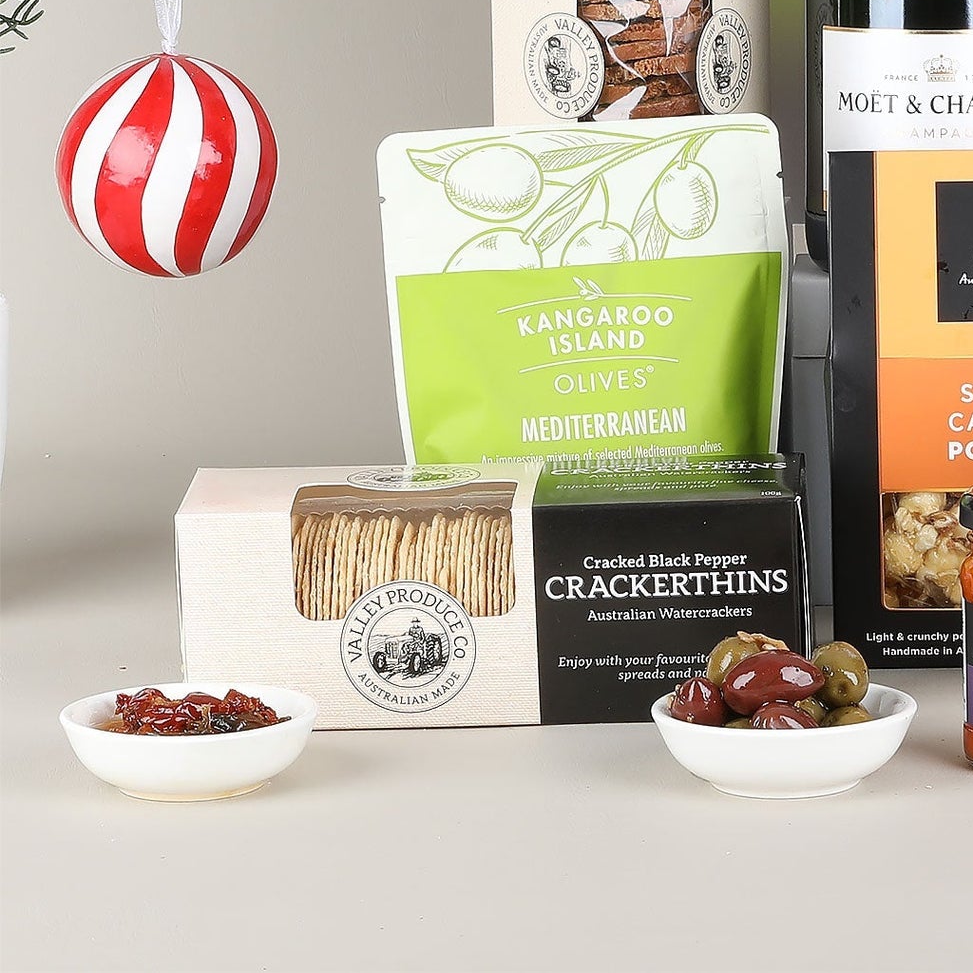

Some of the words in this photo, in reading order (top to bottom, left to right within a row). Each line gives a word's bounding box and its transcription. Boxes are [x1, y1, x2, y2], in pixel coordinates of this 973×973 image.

[554, 18, 596, 52] VALLEY
[719, 16, 749, 41] VALLEY
[528, 23, 549, 79] AUSTRALIAN
[701, 24, 716, 79] AUSTRALIAN
[572, 53, 600, 112] PRODUCE
[728, 38, 751, 102] PRODUCE
[884, 74, 919, 82] FRANCE
[532, 78, 549, 104] MADE
[701, 79, 716, 105] MADE
[838, 89, 899, 114] MOËT
[906, 94, 923, 114] &
[516, 305, 674, 337] KANGAROO
[548, 329, 646, 356] ISLAND
[521, 407, 687, 443] MEDITERRANEAN
[481, 455, 495, 464] An
[495, 452, 544, 465] impressive
[547, 449, 580, 462] mixture
[583, 448, 592, 461] of
[595, 445, 632, 461] selected
[634, 442, 698, 459] Mediterranean
[699, 440, 725, 454] olives.
[550, 462, 788, 476] CRACKERTHINS
[583, 555, 646, 570] Cracked
[648, 553, 692, 568] Black
[694, 553, 748, 570] Pepper
[545, 569, 789, 601] CRACKERTHINS
[347, 595, 384, 663] VALLEY
[385, 588, 464, 633] PRODUCE
[453, 635, 469, 661] CO.
[587, 608, 657, 622] Australian
[658, 606, 753, 620] Watercrackers
[866, 632, 894, 643] Light
[896, 632, 905, 642] &
[907, 631, 949, 643] crunchy
[558, 656, 593, 669] Enjoy
[594, 654, 623, 667] with
[625, 657, 654, 669] your
[882, 647, 940, 656] Handmade
[943, 646, 953, 655] in
[358, 673, 429, 705] AUSTRALIAN
[431, 671, 461, 700] MADE
[618, 668, 666, 683] spreads
[668, 668, 693, 680] and
